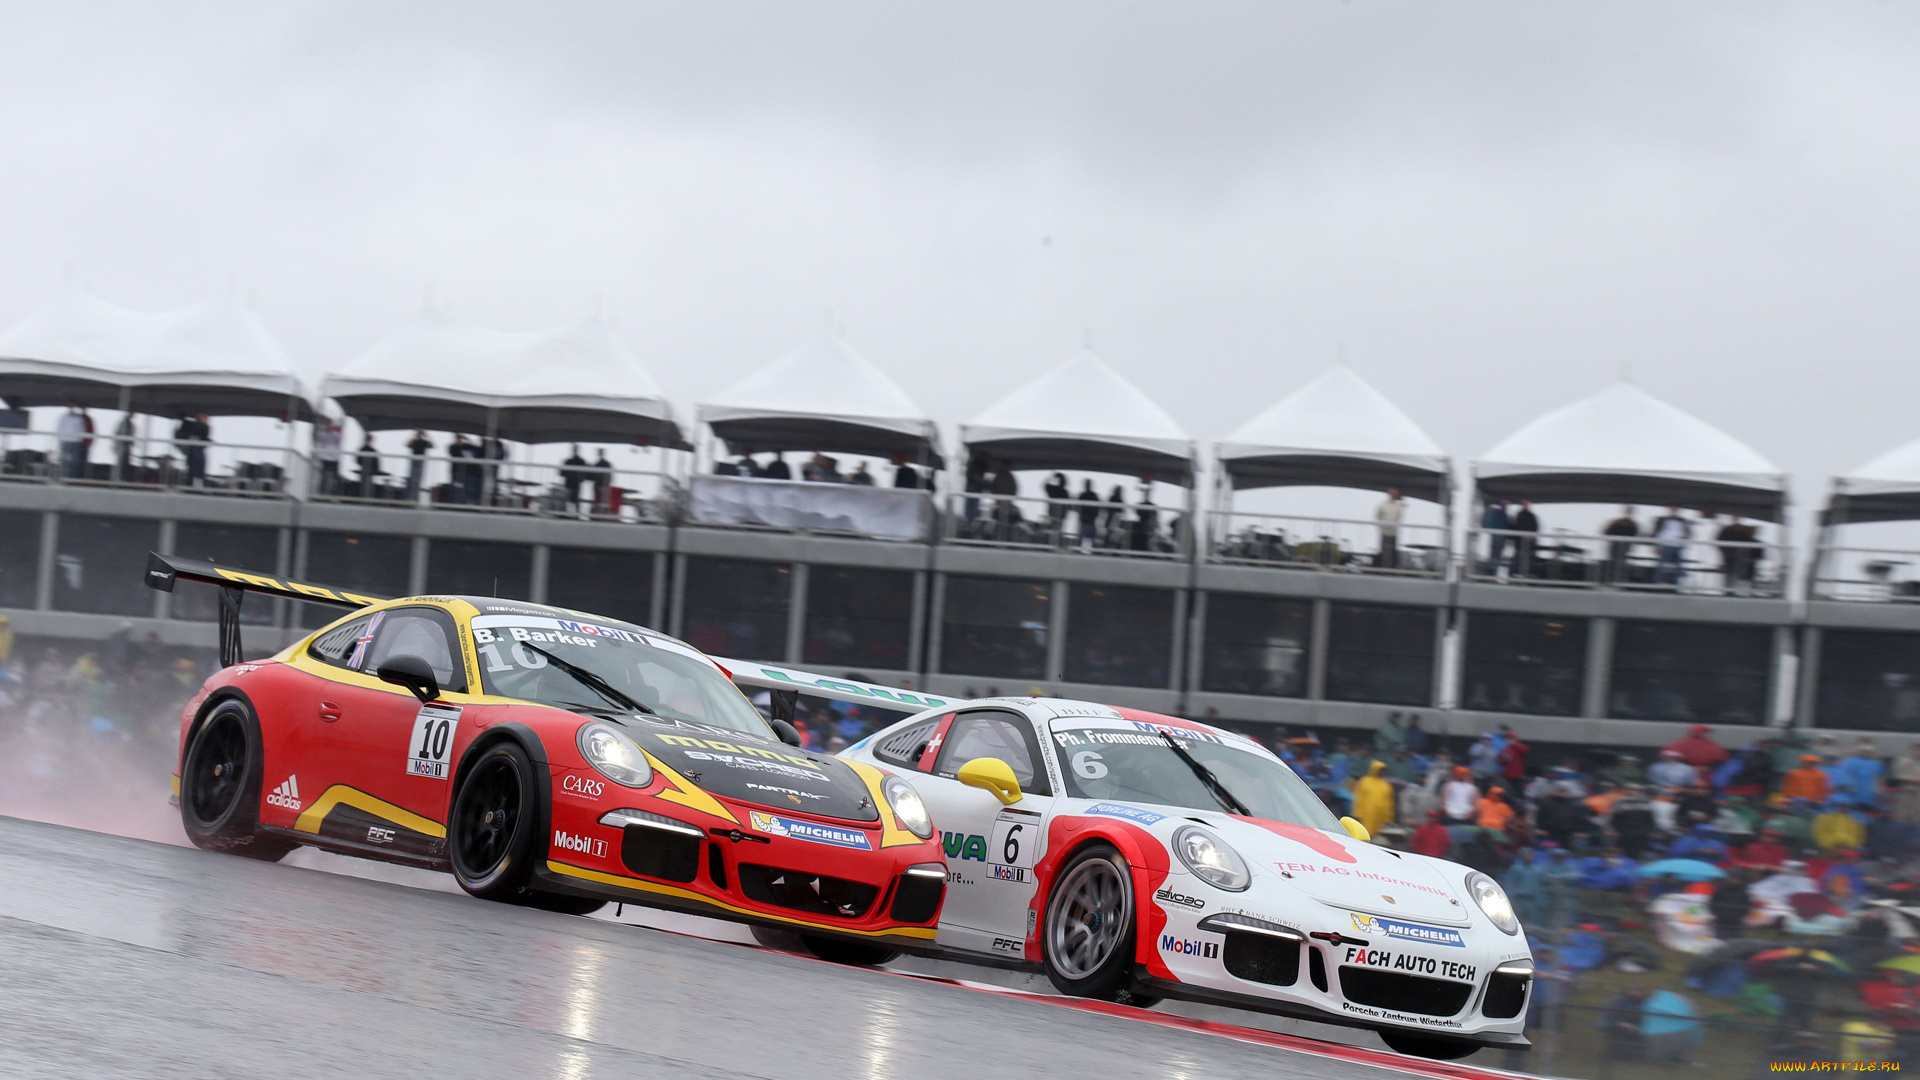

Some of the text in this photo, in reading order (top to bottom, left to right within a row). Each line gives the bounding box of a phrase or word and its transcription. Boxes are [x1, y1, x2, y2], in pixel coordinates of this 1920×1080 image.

[504, 606, 556, 617] Megatron
[473, 627, 597, 648] B. Barker
[557, 620, 629, 641] Mobil
[478, 642, 548, 673] 10
[419, 720, 450, 760] 10
[1053, 733, 1085, 748] Ph.
[1132, 721, 1200, 740] Mobil
[414, 761, 435, 774] Mobil
[1071, 750, 1109, 780] 6
[563, 775, 605, 796] CARS
[266, 794, 302, 810] adidas
[1137, 814, 1160, 823] AG
[367, 826, 397, 841] PFC
[554, 830, 592, 854] Mobil
[790, 823, 866, 844] MICHELIN
[1004, 824, 1024, 865] 6
[995, 866, 1016, 879] Mobil
[1273, 862, 1451, 900] TEN AG Informatik
[1268, 916, 1301, 930] SCHWEIZ
[1388, 924, 1460, 943] MICHELIN
[992, 937, 1023, 951] PFC
[1162, 934, 1202, 957] Mobil
[1345, 947, 1477, 981] FACH AUTO TECH
[1342, 1002, 1463, 1029] Porsche Zentrum Winterthur
